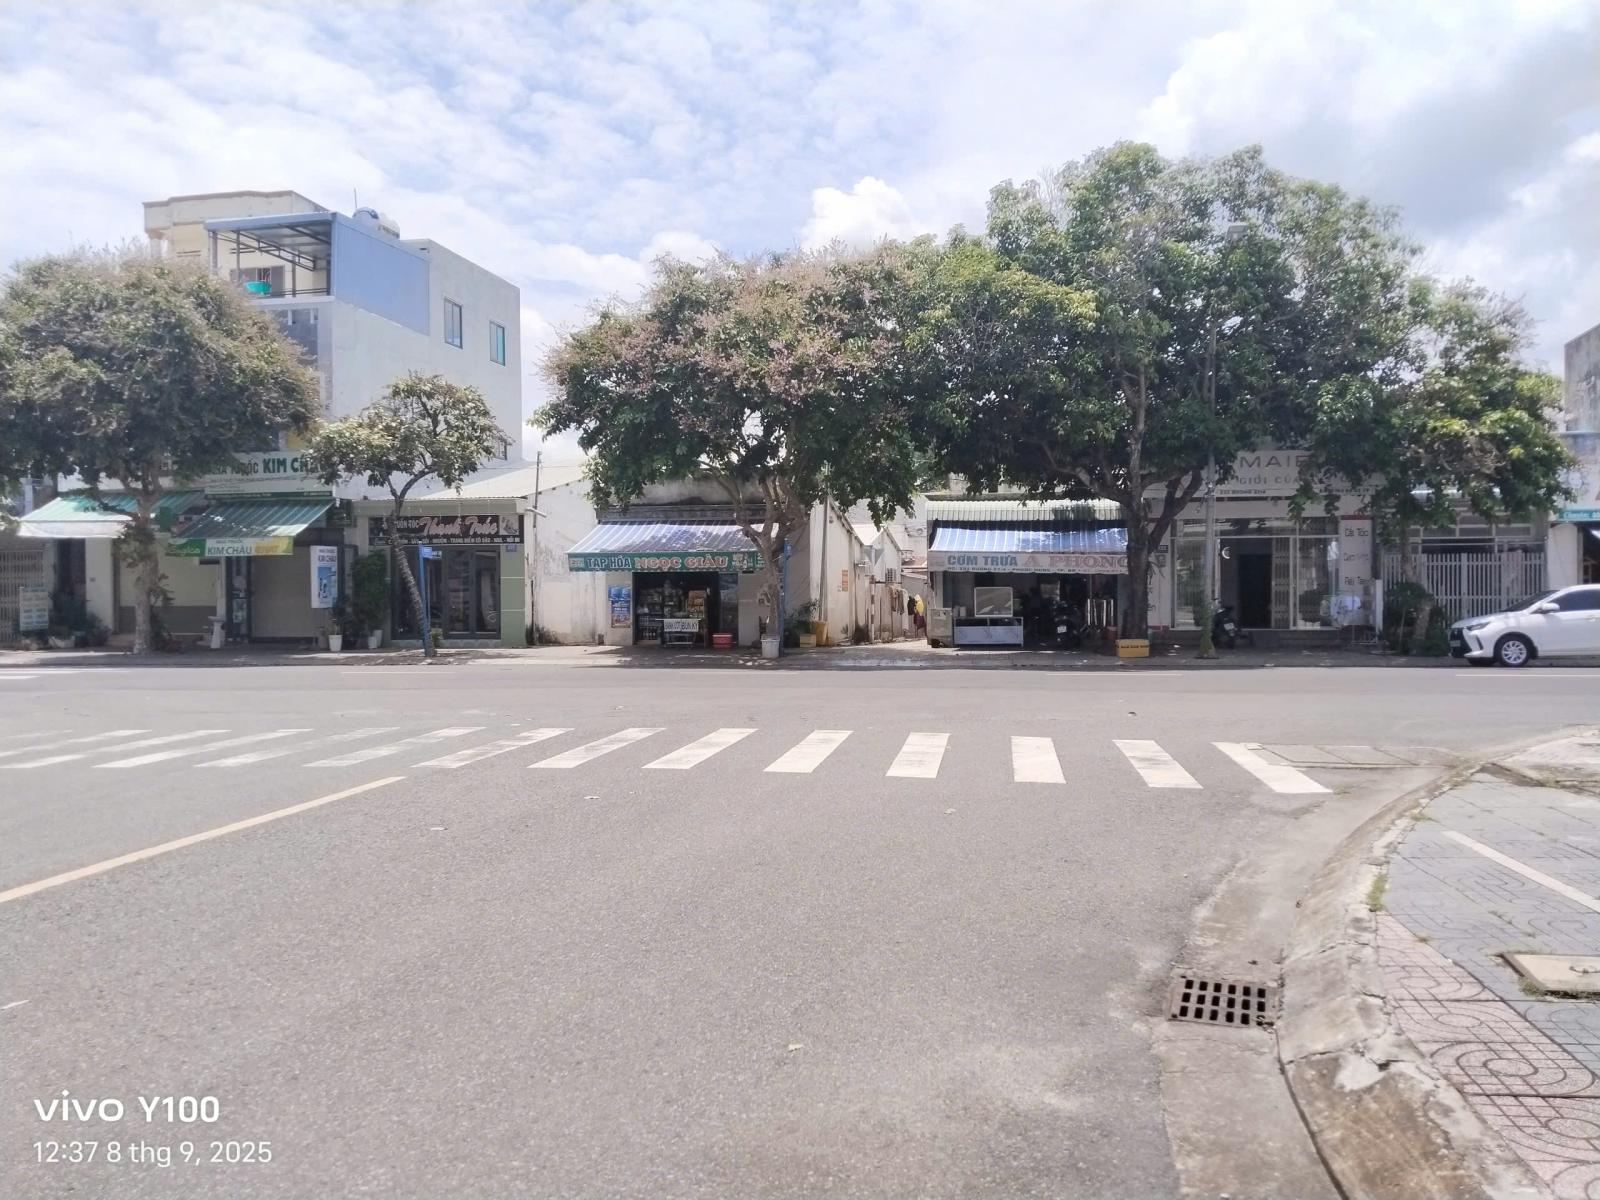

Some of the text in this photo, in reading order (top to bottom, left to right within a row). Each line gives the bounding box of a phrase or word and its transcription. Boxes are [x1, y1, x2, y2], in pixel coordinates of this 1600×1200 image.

[263, 457, 287, 473] KIM
[207, 547, 225, 555] KIM
[587, 557, 608, 571] TẠP
[634, 557, 682, 572] NGỌC
[684, 554, 729, 568] GIÀU
[947, 554, 978, 566] CƠM
[982, 554, 1018, 566] TRƯA
[1024, 555, 1041, 568] A
